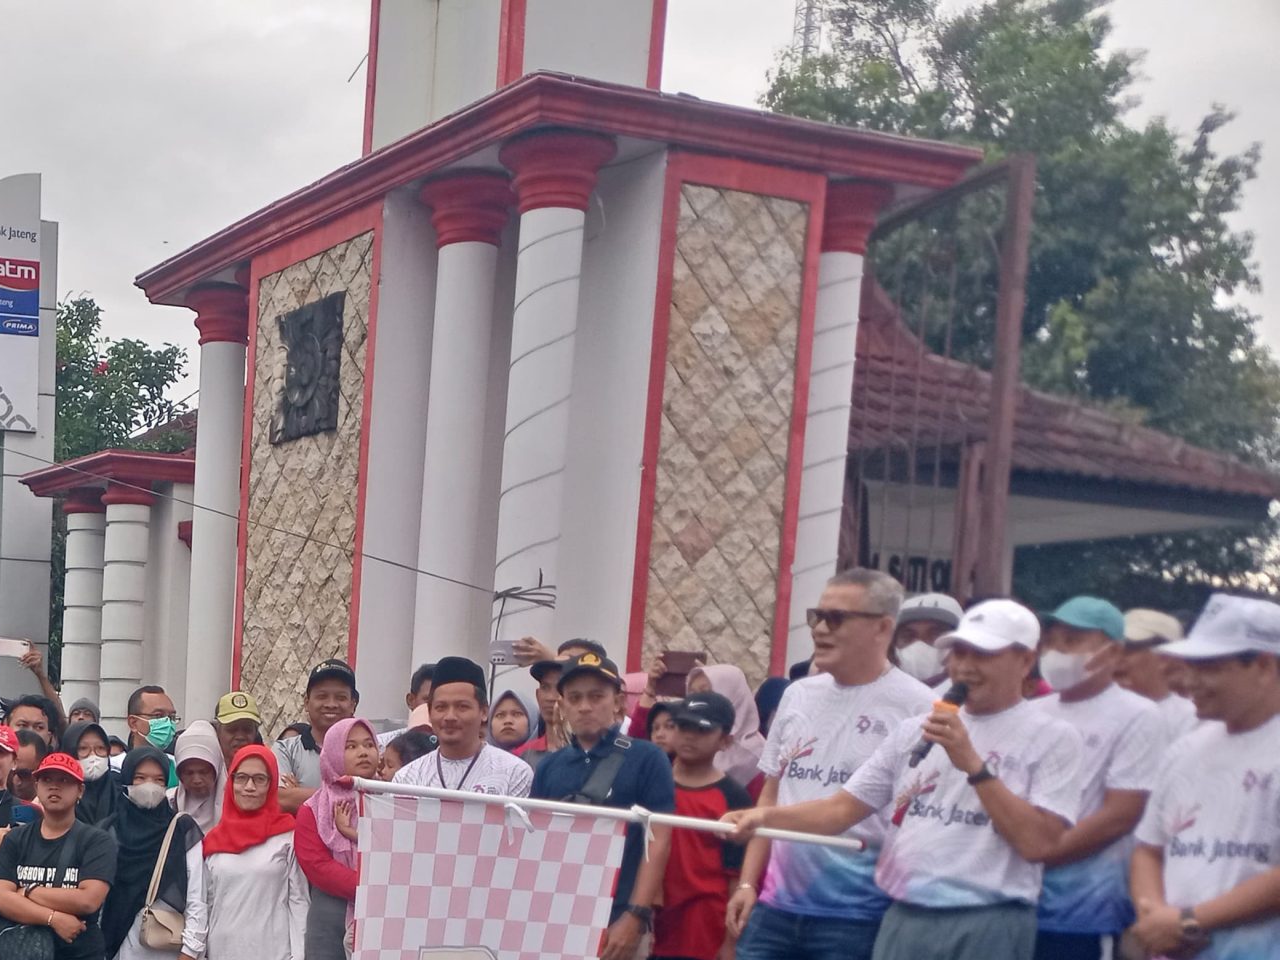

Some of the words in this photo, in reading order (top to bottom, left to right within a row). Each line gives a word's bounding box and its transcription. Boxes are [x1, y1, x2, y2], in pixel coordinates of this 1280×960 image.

[8, 227, 37, 243] Jateng
[6, 321, 33, 331] PRIMA
[788, 761, 823, 781] Bank
